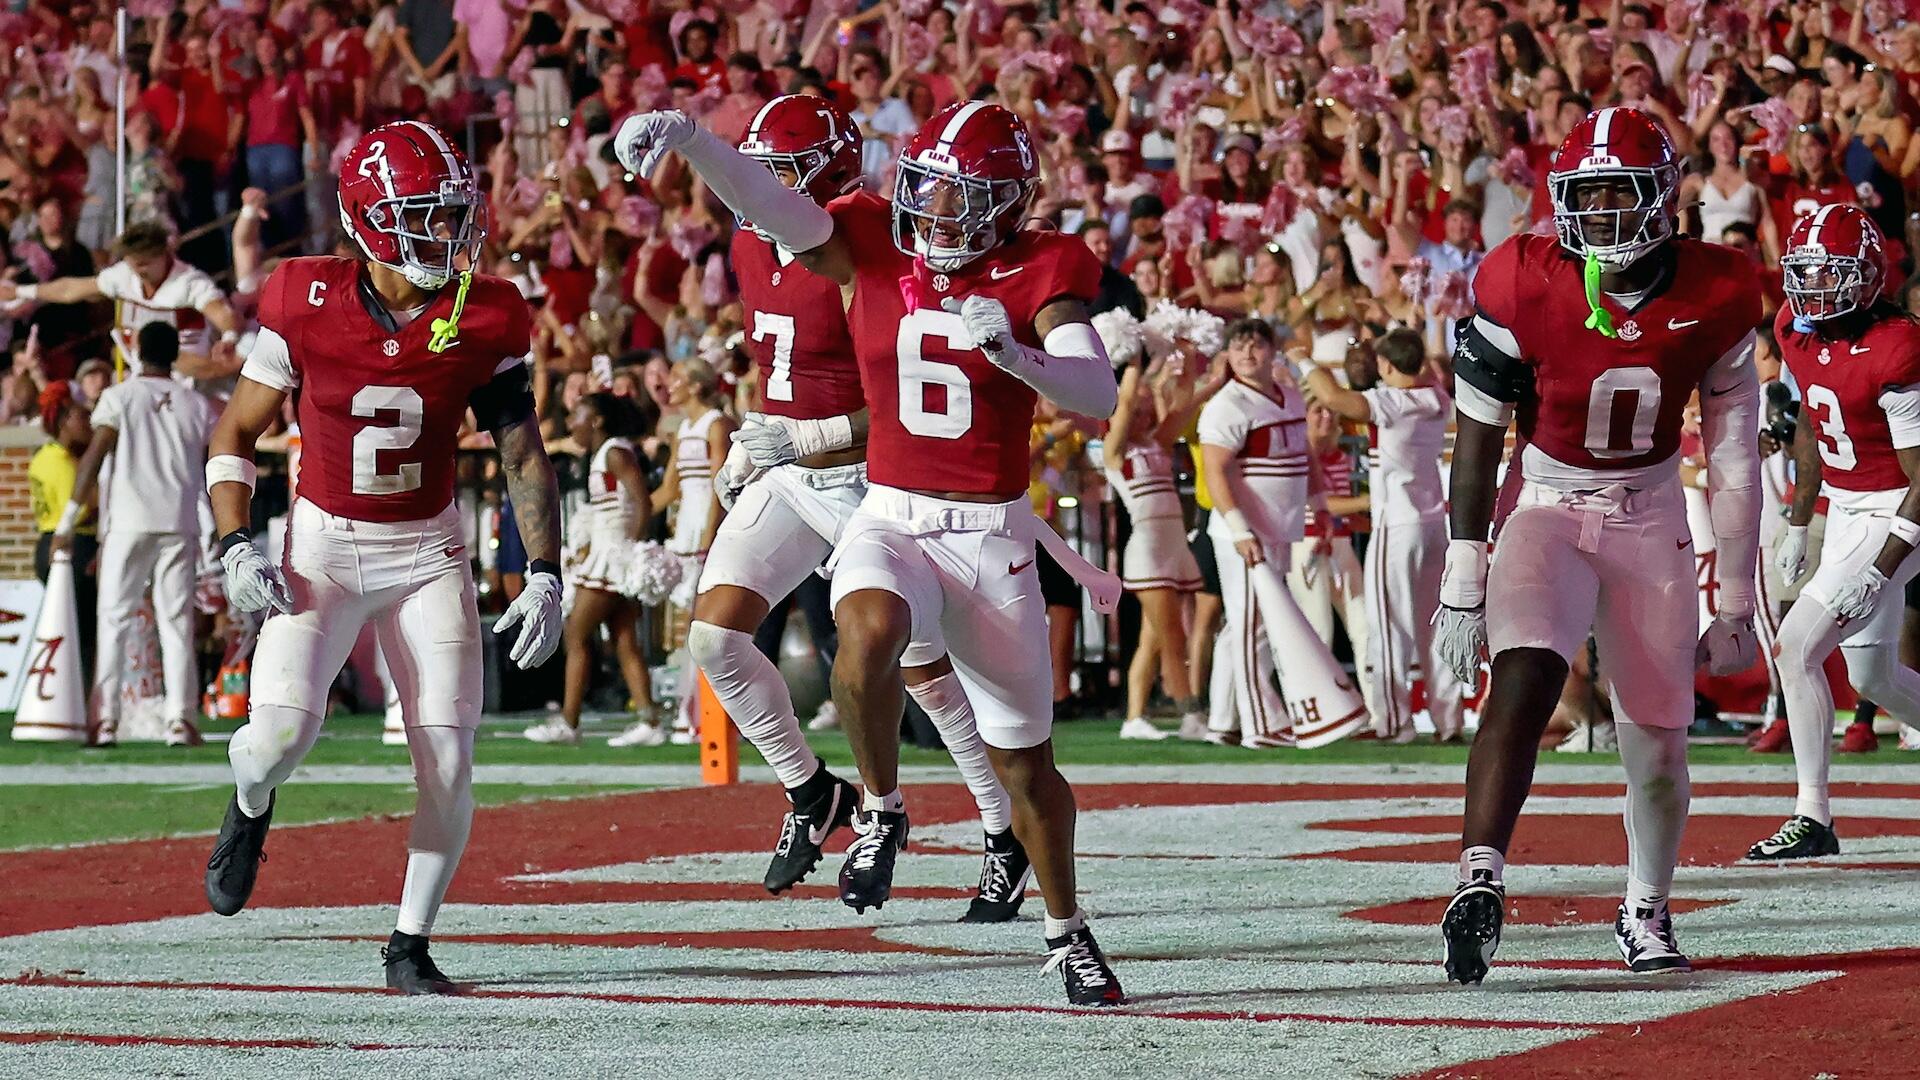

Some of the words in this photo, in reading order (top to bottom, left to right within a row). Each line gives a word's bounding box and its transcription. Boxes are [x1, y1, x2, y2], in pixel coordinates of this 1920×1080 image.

[816, 109, 838, 140] 7
[358, 140, 386, 178] 2
[928, 151, 950, 164] BAMA
[1589, 157, 1612, 165] BAMA
[308, 280, 327, 307] C
[932, 274, 950, 292] SEC
[382, 339, 400, 357] SEC
[751, 310, 796, 402] 7
[897, 308, 974, 440] 6
[1584, 366, 1662, 459] 0
[1807, 383, 1858, 471] 3
[351, 384, 424, 495] 2
[28, 635, 64, 701] A
